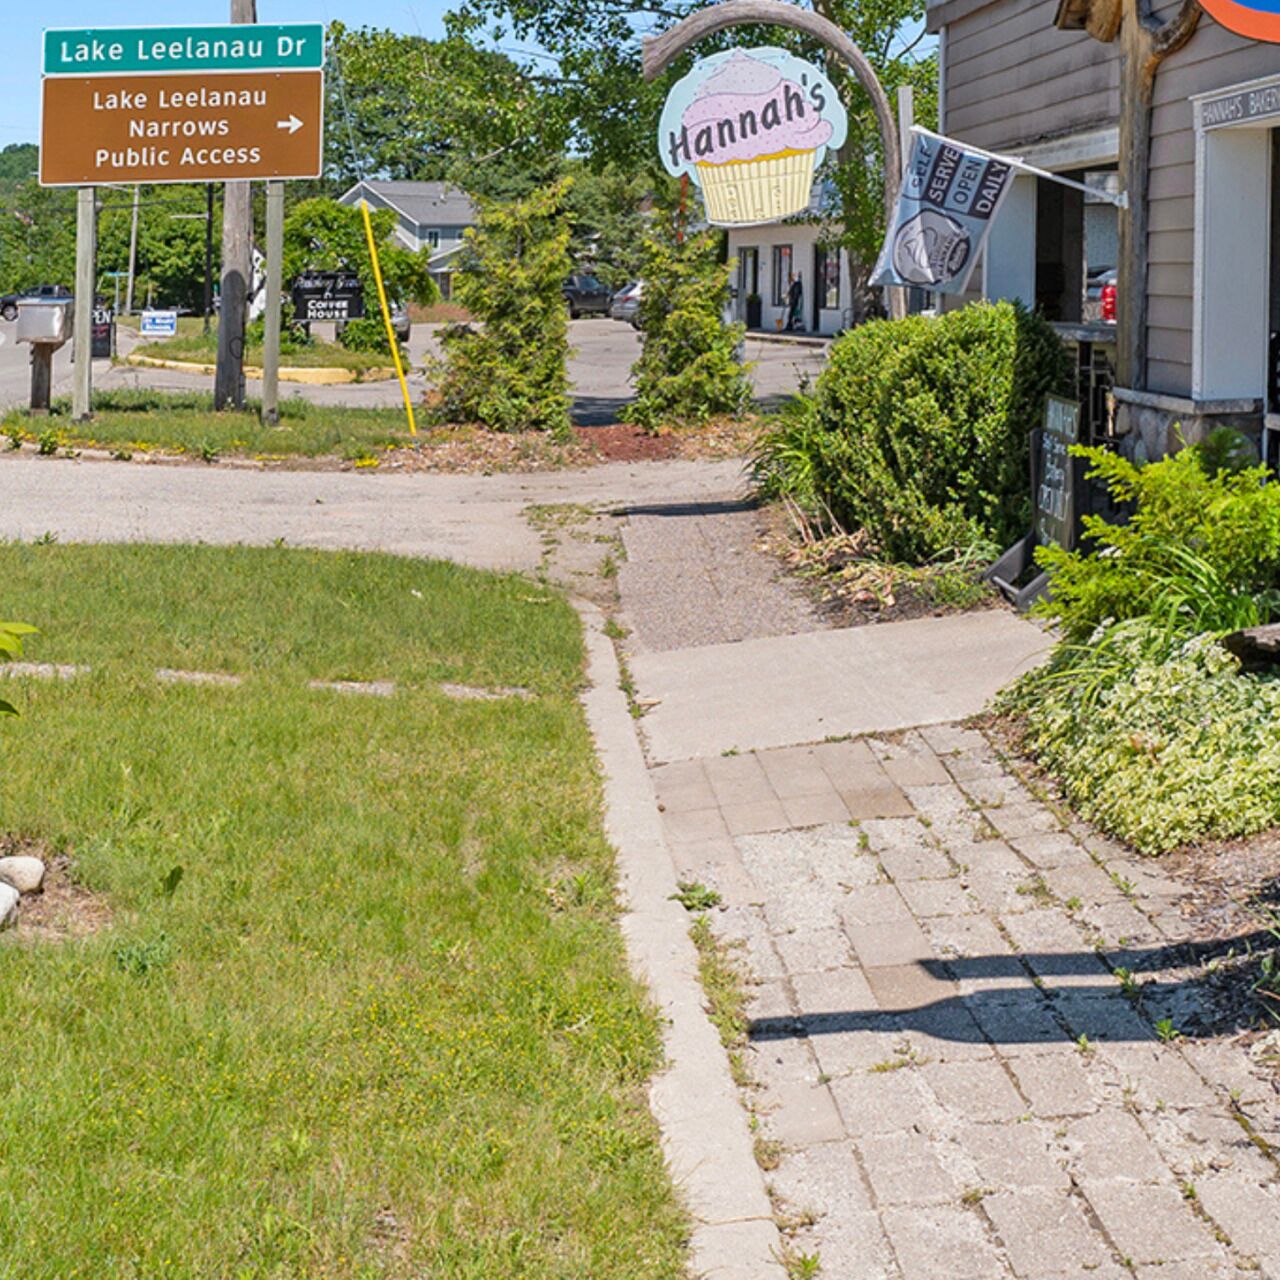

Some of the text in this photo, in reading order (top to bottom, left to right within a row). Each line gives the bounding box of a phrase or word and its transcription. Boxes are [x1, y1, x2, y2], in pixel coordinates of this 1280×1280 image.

[61, 36, 307, 62] Lake Leelanau Dr
[93, 88, 267, 110] Lake Leelanau
[669, 73, 826, 166] Hannah's
[129, 119, 229, 137] Narrows
[95, 147, 261, 168] Public Access
[912, 146, 931, 188] SELF
[928, 146, 960, 202] SERVE
[953, 159, 982, 205] OPEN
[976, 162, 1008, 213] DAILY
